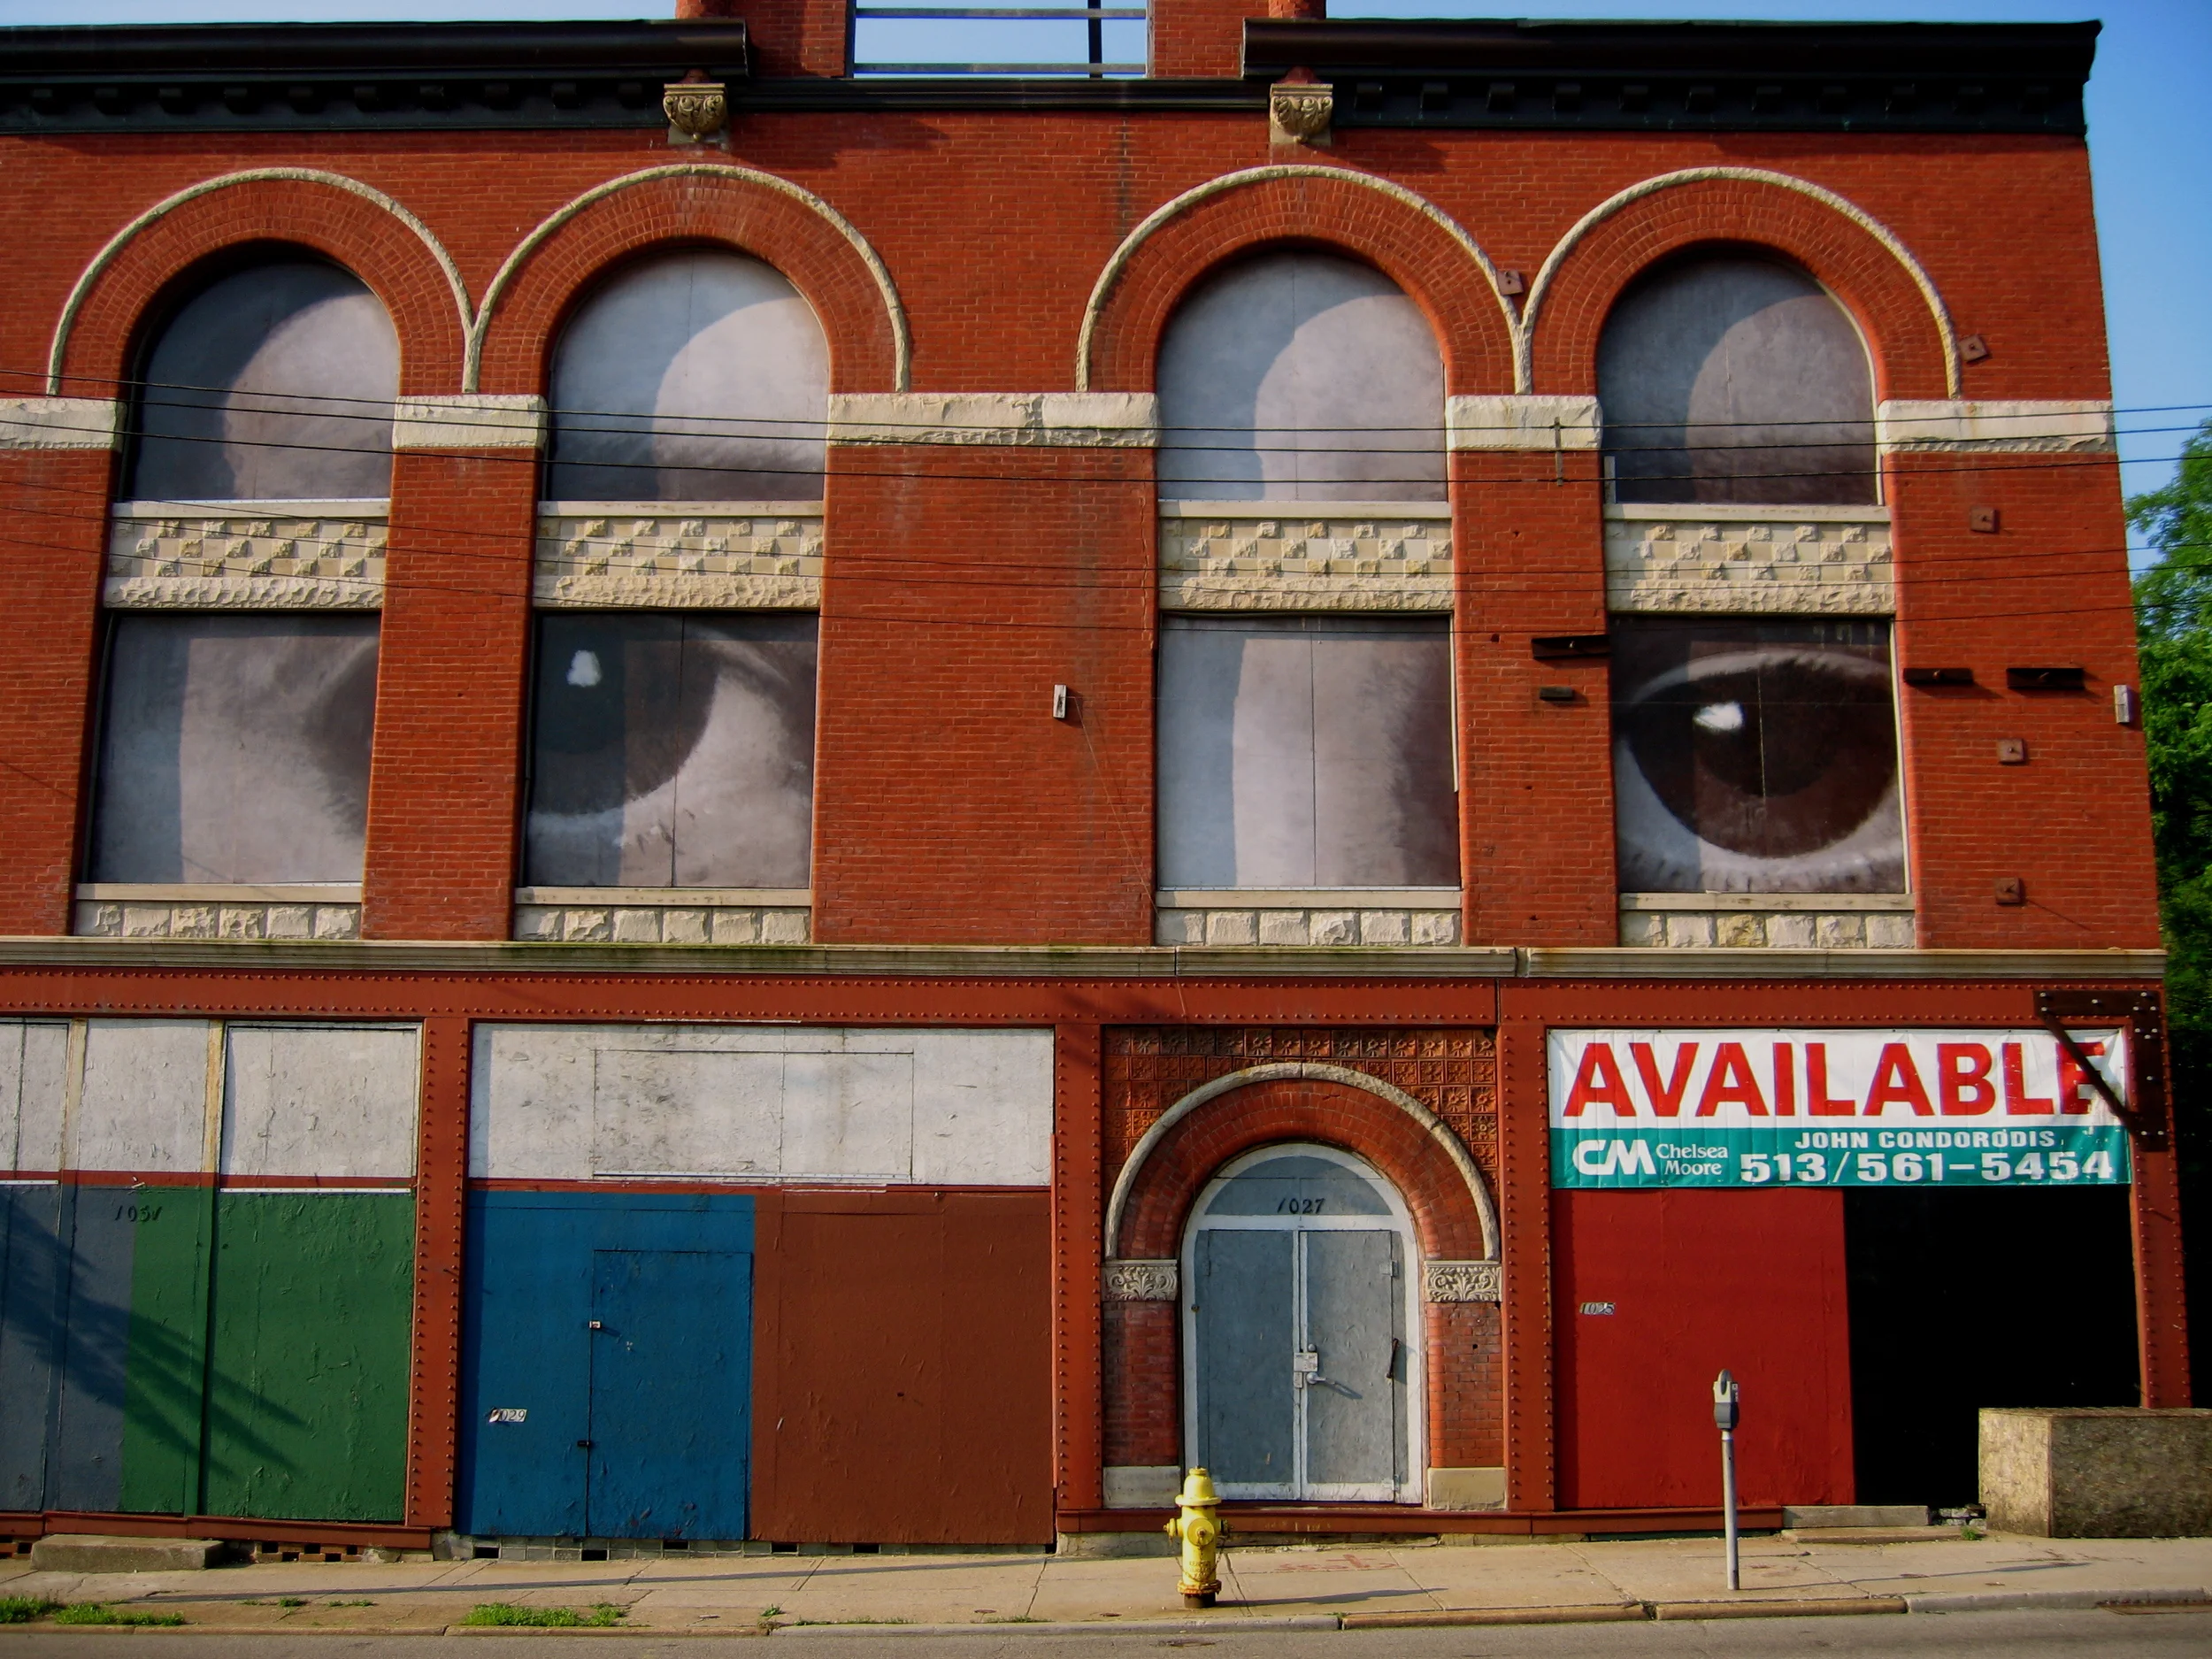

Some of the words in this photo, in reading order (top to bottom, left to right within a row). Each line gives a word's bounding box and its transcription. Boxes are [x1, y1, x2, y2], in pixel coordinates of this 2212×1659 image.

[1563, 1041, 2106, 1118] AVAILABLE
[1794, 1132, 1869, 1148] JOHN
[1878, 1130, 2056, 1148] CONDORODIS
[1572, 1139, 1656, 1176] CM
[1656, 1143, 1729, 1159] Chelsea
[1664, 1160, 1723, 1175] Moore
[1740, 1150, 2114, 1184] 513/561-5454
[1277, 1197, 1325, 1215] 1027
[489, 1408, 526, 1423] 029
